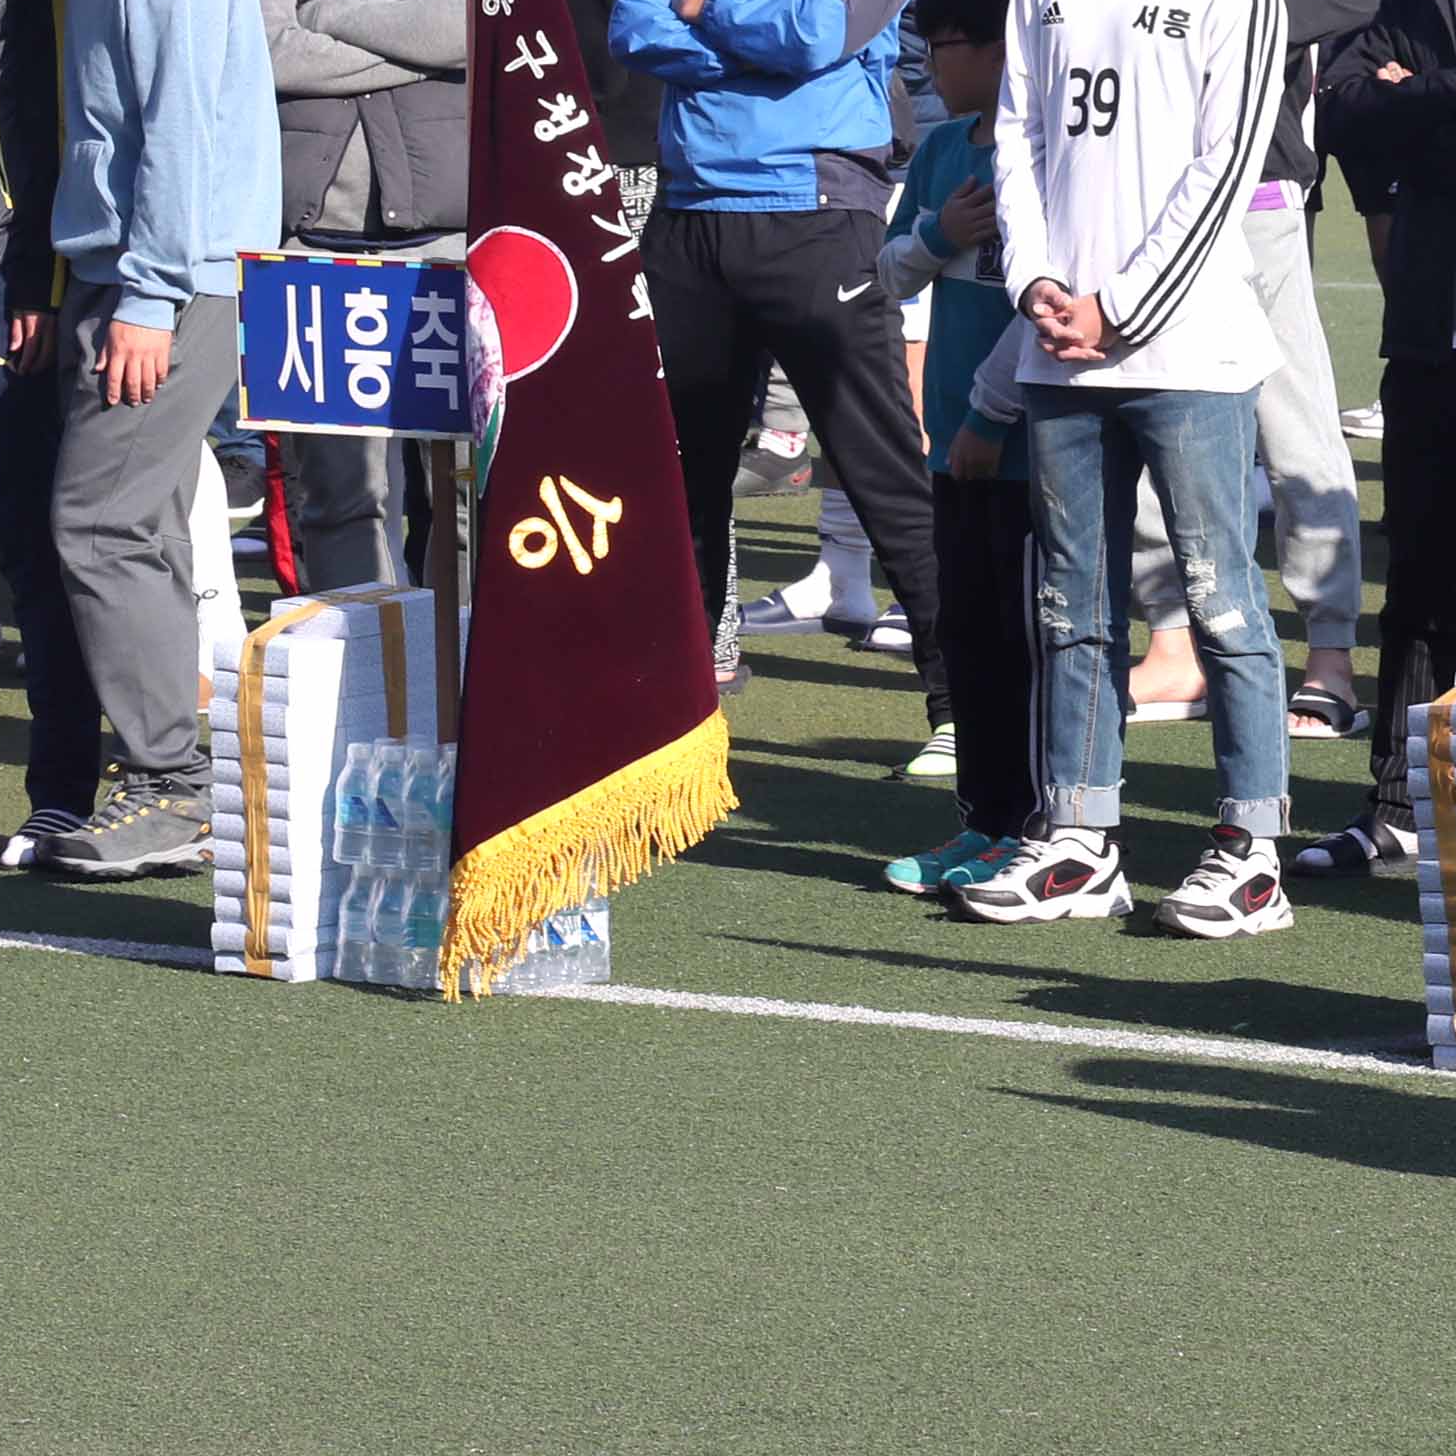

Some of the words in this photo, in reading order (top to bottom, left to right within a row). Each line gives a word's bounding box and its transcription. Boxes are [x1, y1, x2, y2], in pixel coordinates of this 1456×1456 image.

[1132, 5, 1192, 39] 서흥
[1066, 67, 1121, 137] 39
[277, 283, 460, 411] 서흥축
